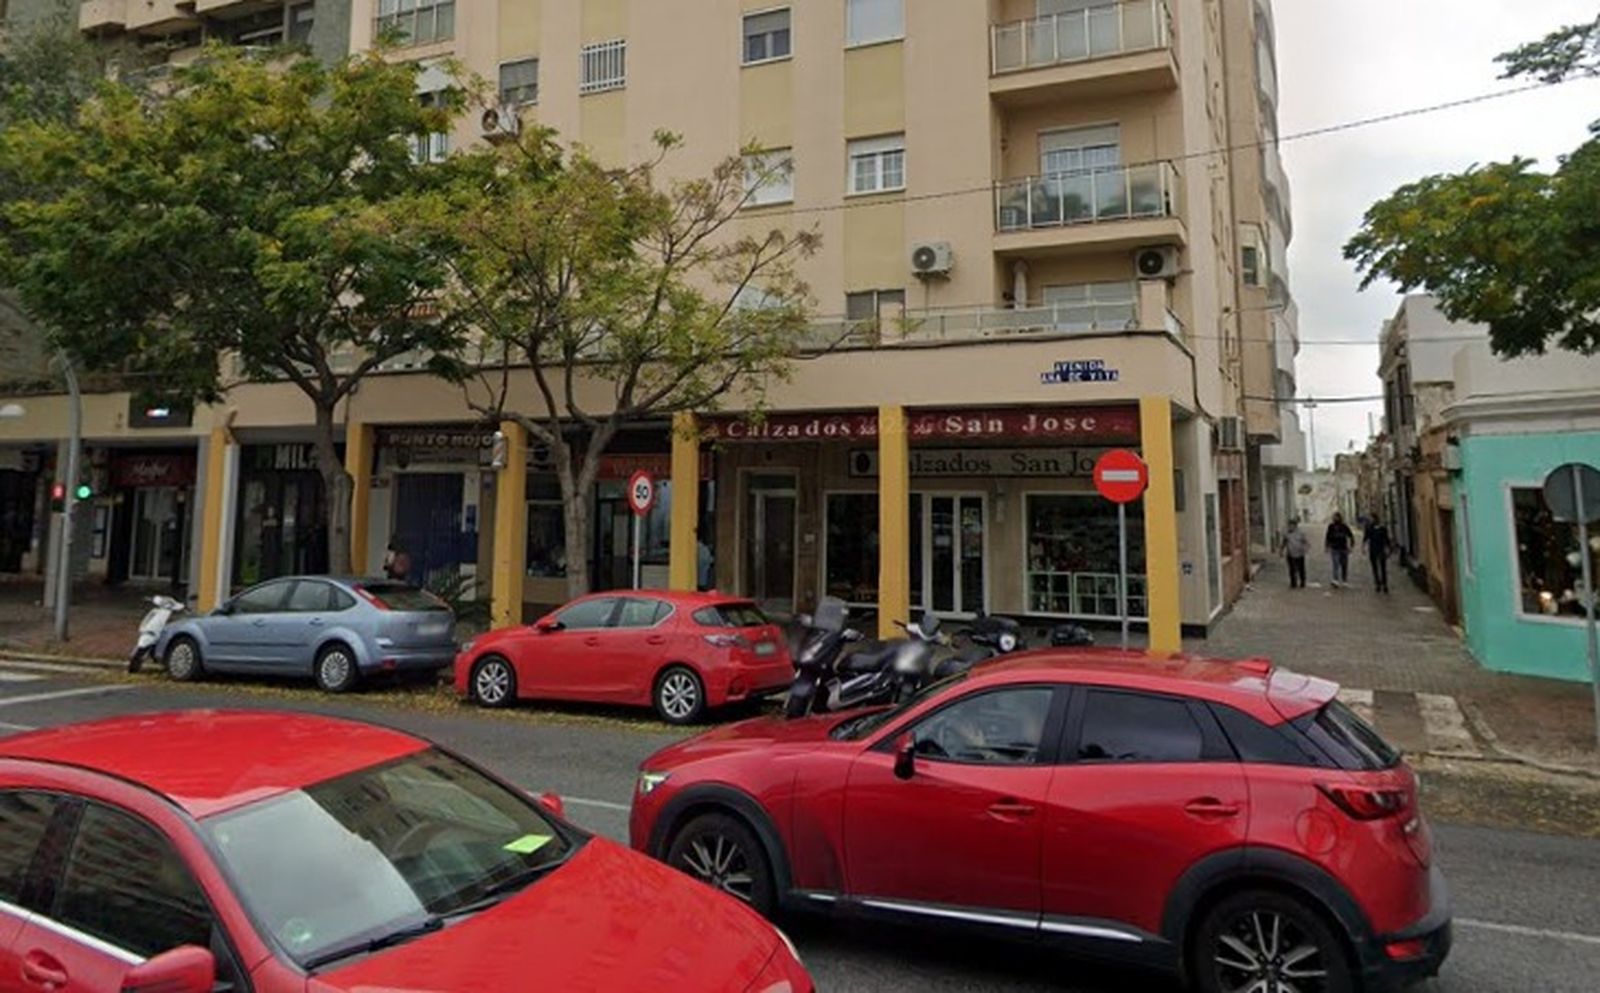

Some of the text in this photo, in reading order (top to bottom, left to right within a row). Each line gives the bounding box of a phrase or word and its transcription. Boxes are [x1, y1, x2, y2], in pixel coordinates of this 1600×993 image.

[1054, 361, 1104, 372] AVENIDA
[1069, 371, 1082, 381] DE
[726, 420, 851, 437] Calzados
[945, 412, 1097, 434] San Jose
[389, 433, 449, 446] PUNTO
[1010, 452, 1060, 474] San
[1067, 450, 1095, 477] Jo
[635, 484, 648, 500] 50
